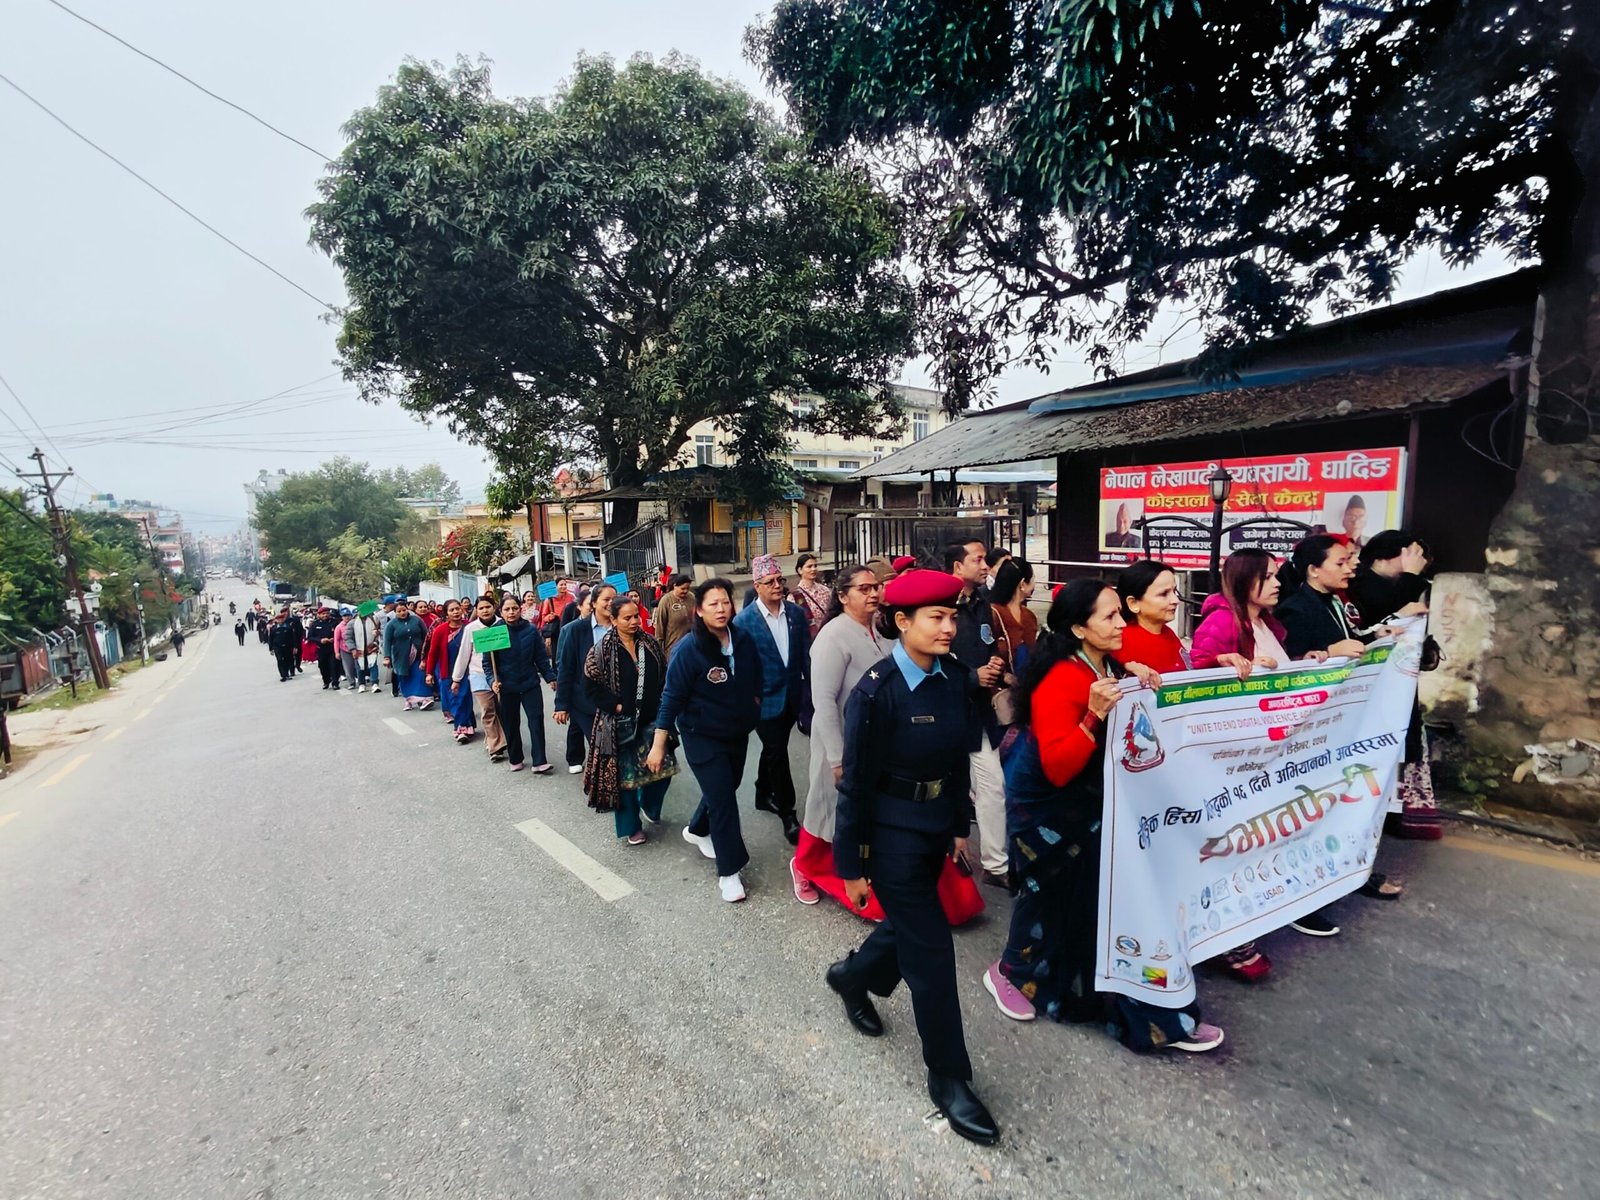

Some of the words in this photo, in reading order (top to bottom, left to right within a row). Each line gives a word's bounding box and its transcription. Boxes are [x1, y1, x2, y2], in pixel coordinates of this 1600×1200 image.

[1105, 469, 1146, 489] नेपाल
[1262, 711, 1298, 725] VIOLENCE
[1164, 806, 1203, 826] हिंसा
[1233, 784, 1248, 800] १६
[1249, 771, 1271, 795] दिने
[1275, 750, 1332, 784] अभियानको
[1336, 732, 1399, 762] अवसरमा
[1262, 885, 1285, 901] USAID
